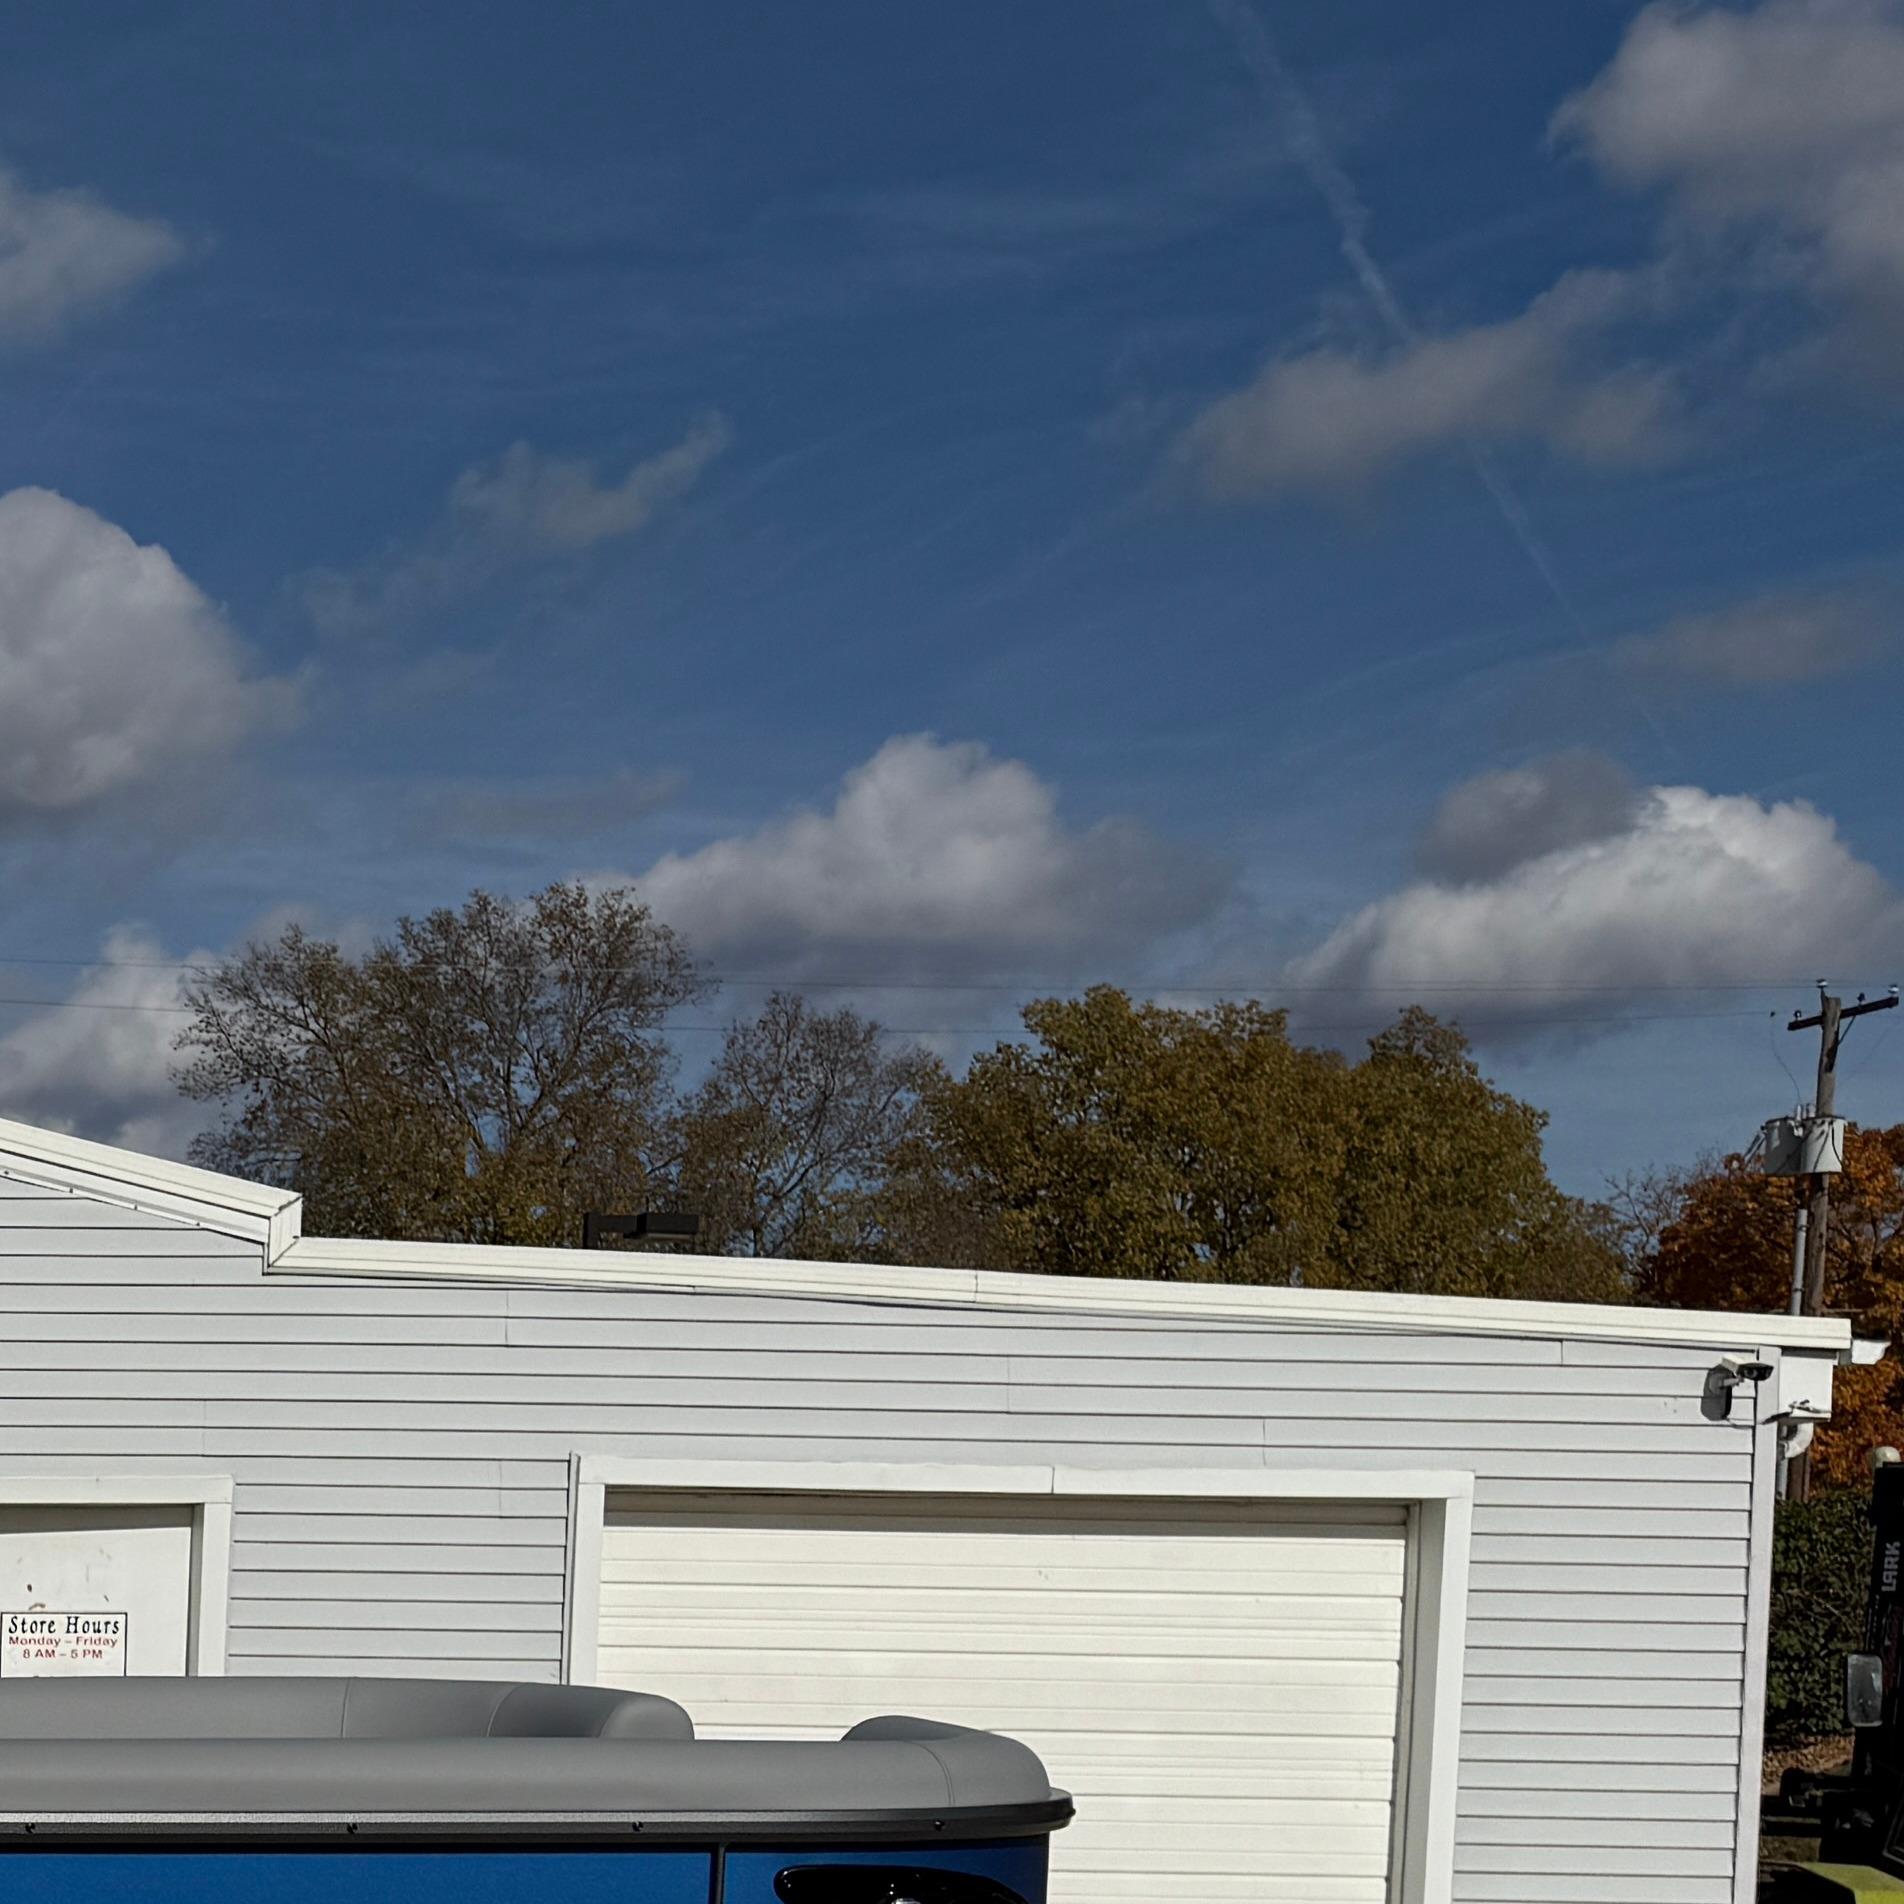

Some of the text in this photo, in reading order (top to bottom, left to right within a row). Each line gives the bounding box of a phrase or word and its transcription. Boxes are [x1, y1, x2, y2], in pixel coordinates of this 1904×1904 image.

[8, 1616, 120, 1634] Store Hours
[8, 1636, 61, 1647] Monday
[75, 1636, 118, 1647] Friday
[35, 1649, 56, 1659] AM
[82, 1649, 103, 1659] PM
